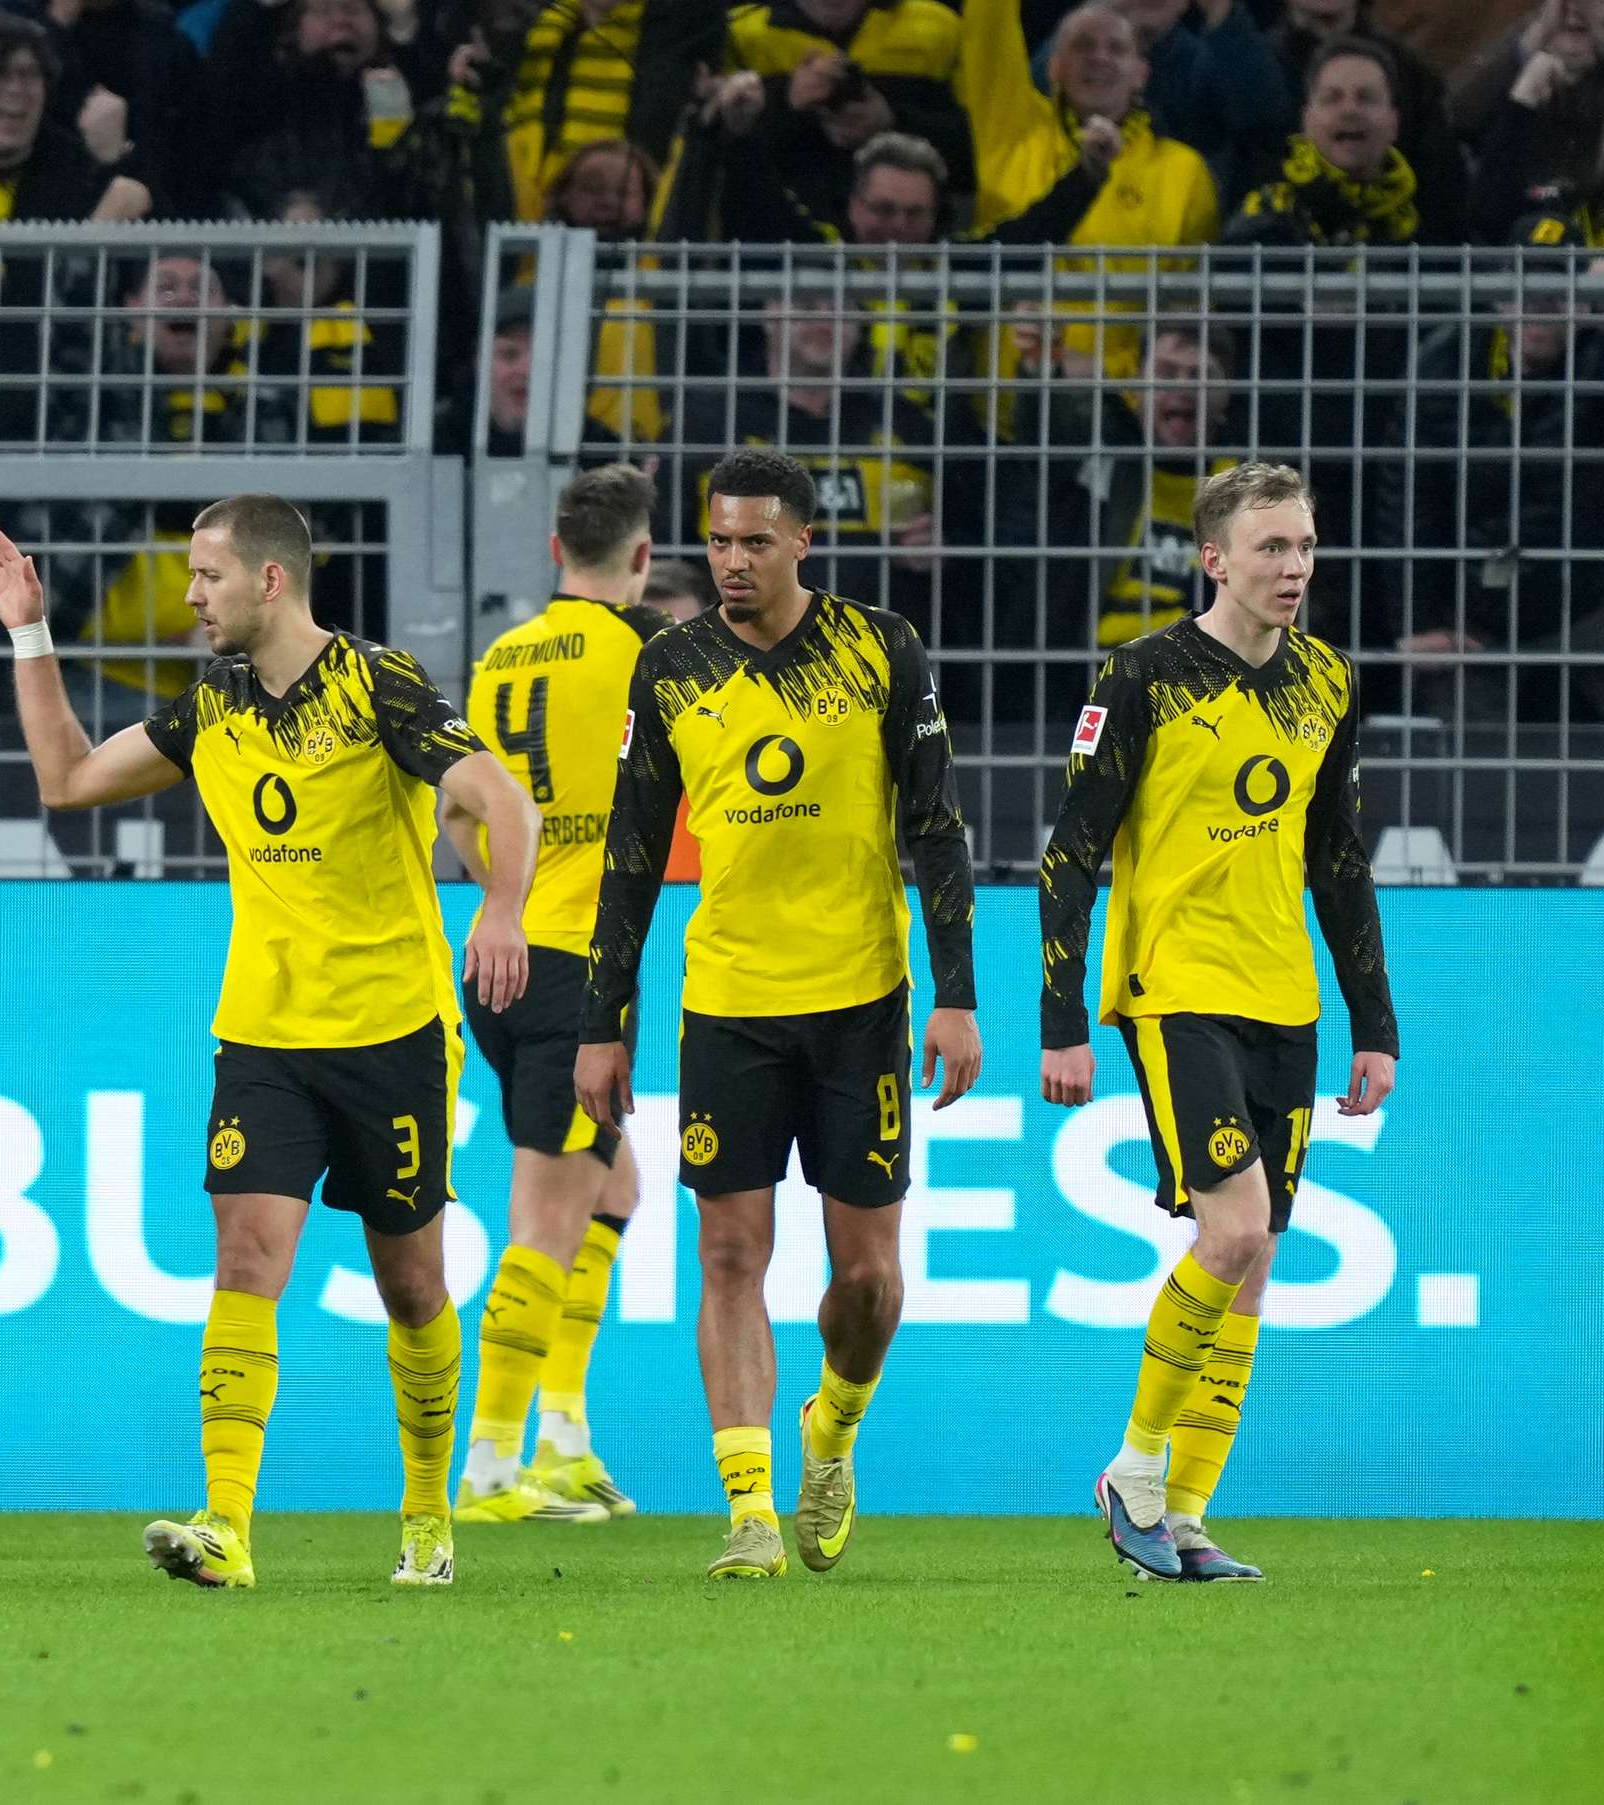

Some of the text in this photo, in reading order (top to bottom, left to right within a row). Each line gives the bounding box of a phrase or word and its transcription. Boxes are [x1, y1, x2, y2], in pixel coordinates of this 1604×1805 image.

[485, 633, 585, 671] DORTMUND
[817, 690, 848, 715] BVB
[826, 713, 839, 724] 09
[1302, 717, 1328, 743] BVB
[496, 676, 554, 804] 4
[724, 802, 822, 825] vodafone
[248, 843, 322, 863] vodafone
[876, 1072, 902, 1142] 8
[215, 1133, 241, 1159] BVB
[392, 1113, 421, 1180] 3
[686, 1127, 714, 1153] BVB
[1214, 1131, 1245, 1157] BVB
[693, 1151, 705, 1161] 09
